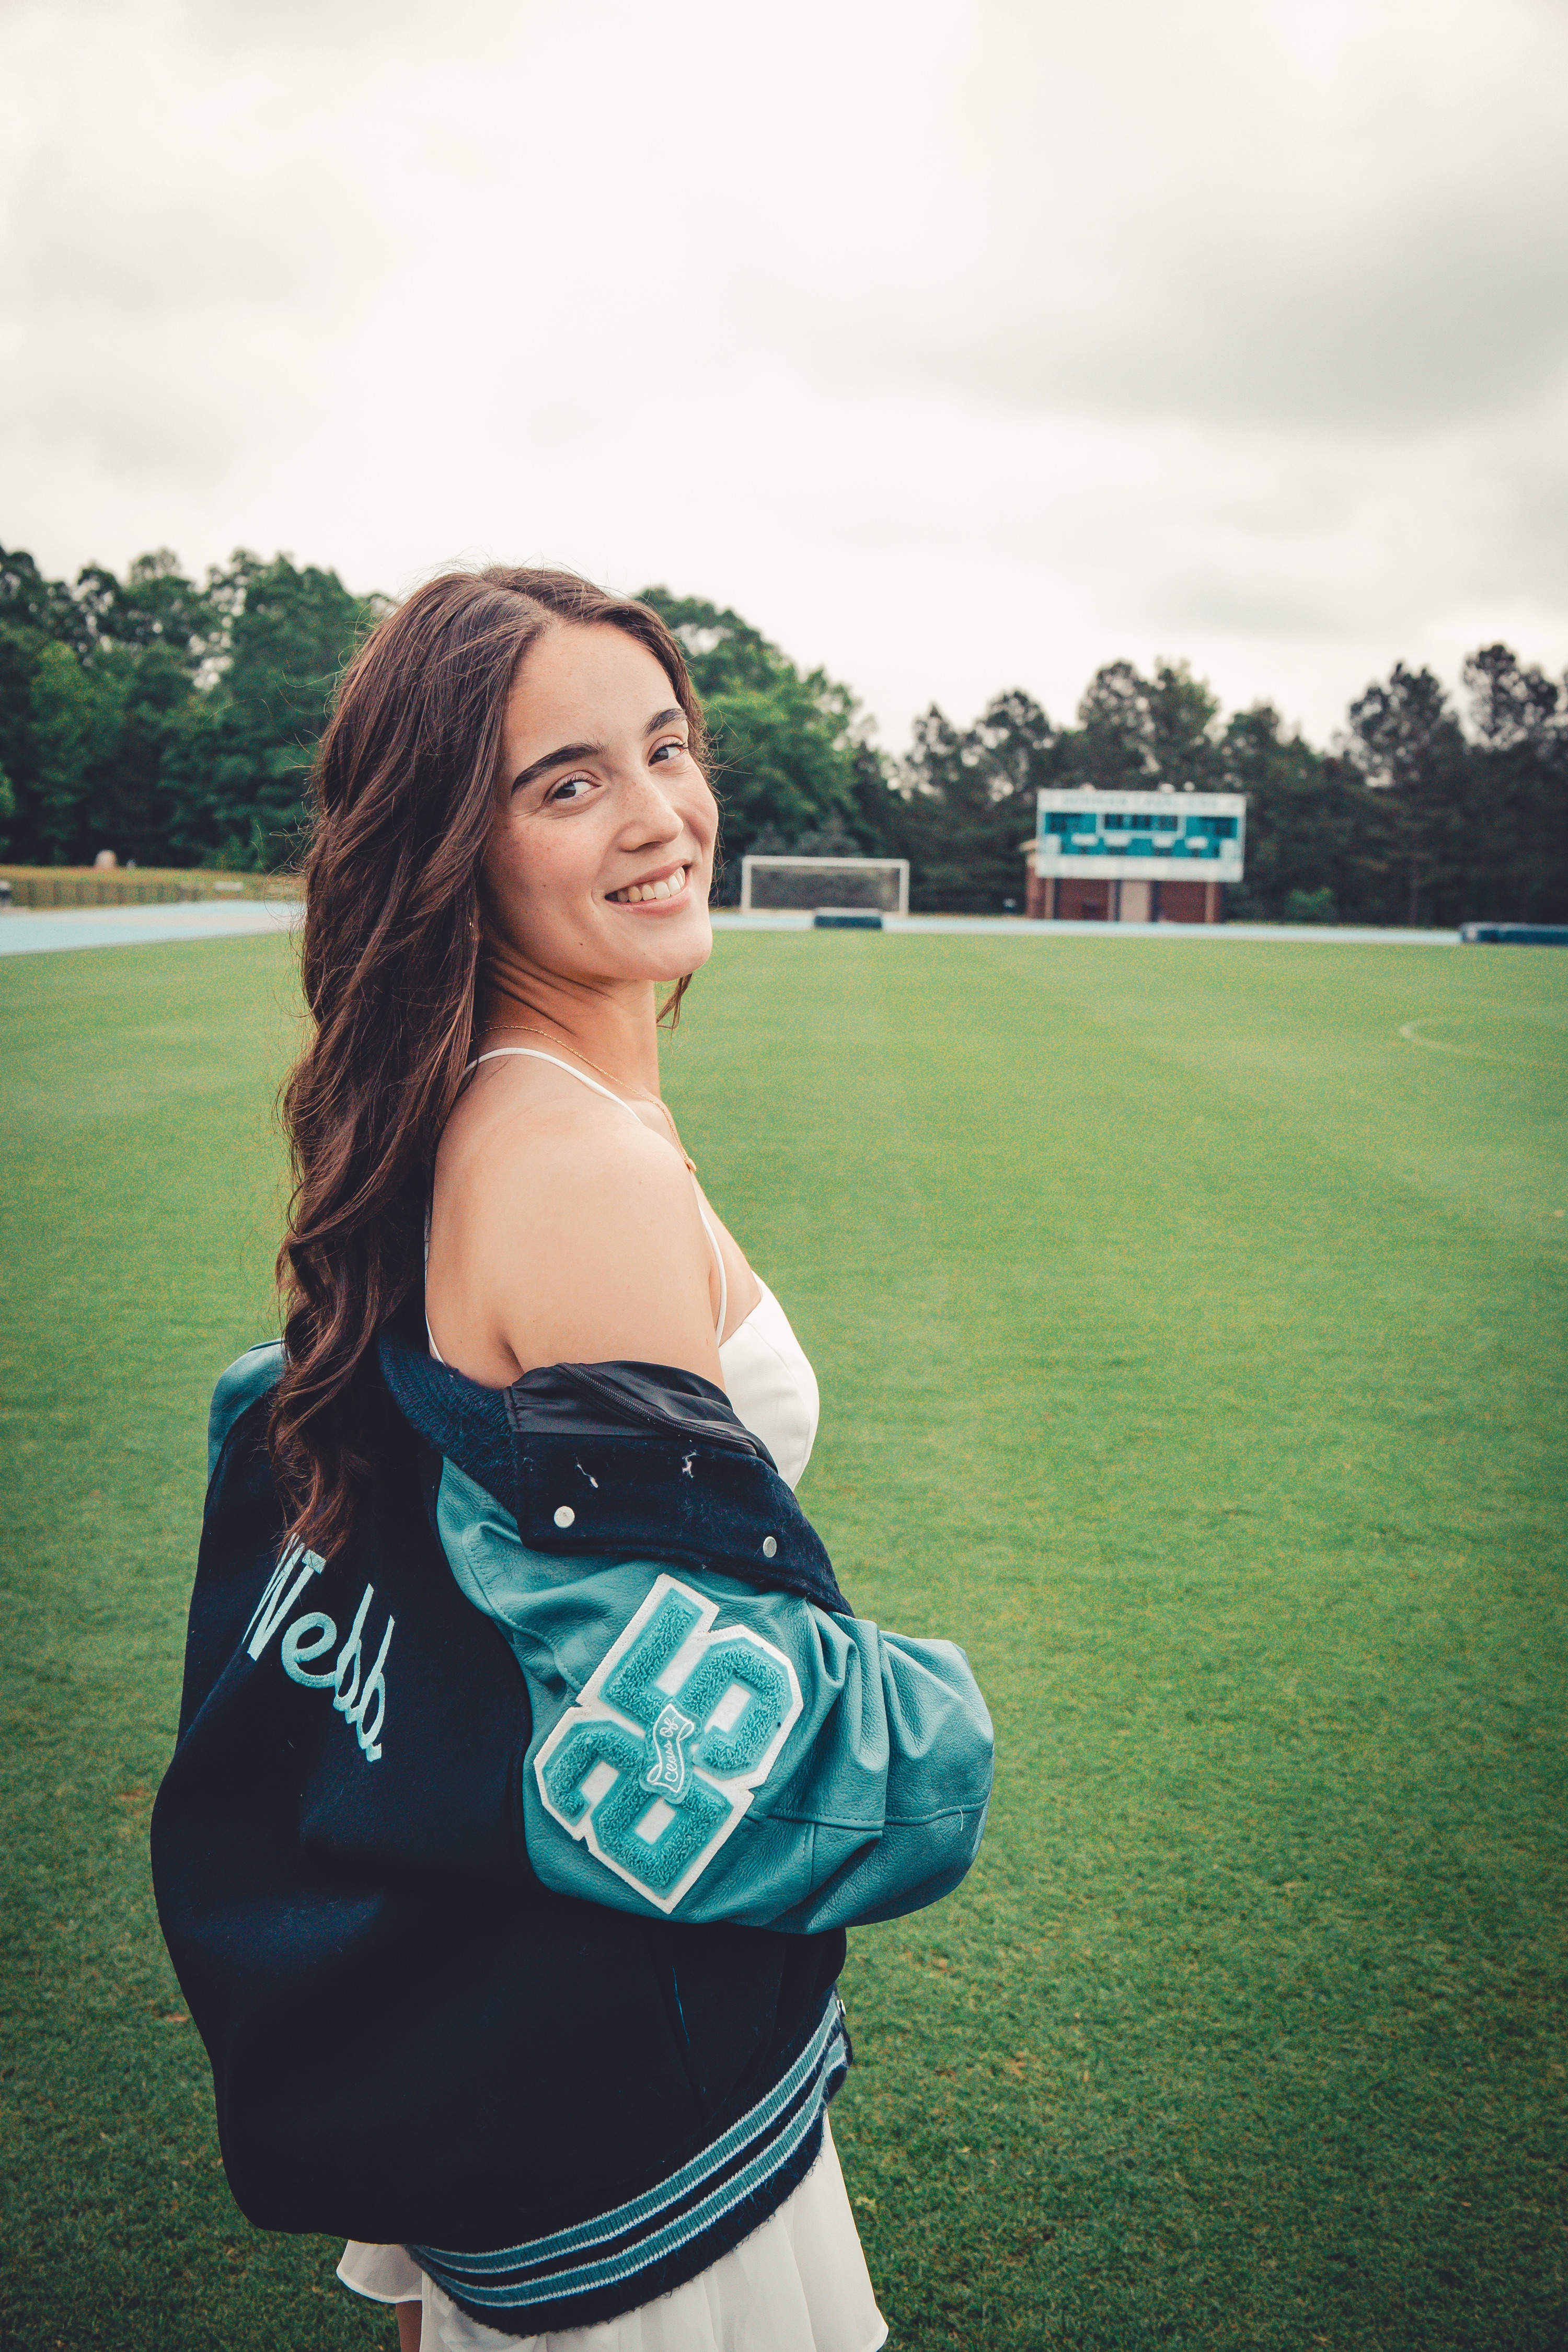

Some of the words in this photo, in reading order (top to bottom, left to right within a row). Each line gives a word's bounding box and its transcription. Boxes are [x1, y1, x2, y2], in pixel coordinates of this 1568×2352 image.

[241, 1532, 395, 1762] Webb
[535, 1574, 802, 1912] 25
[664, 1740, 678, 1782] Class
